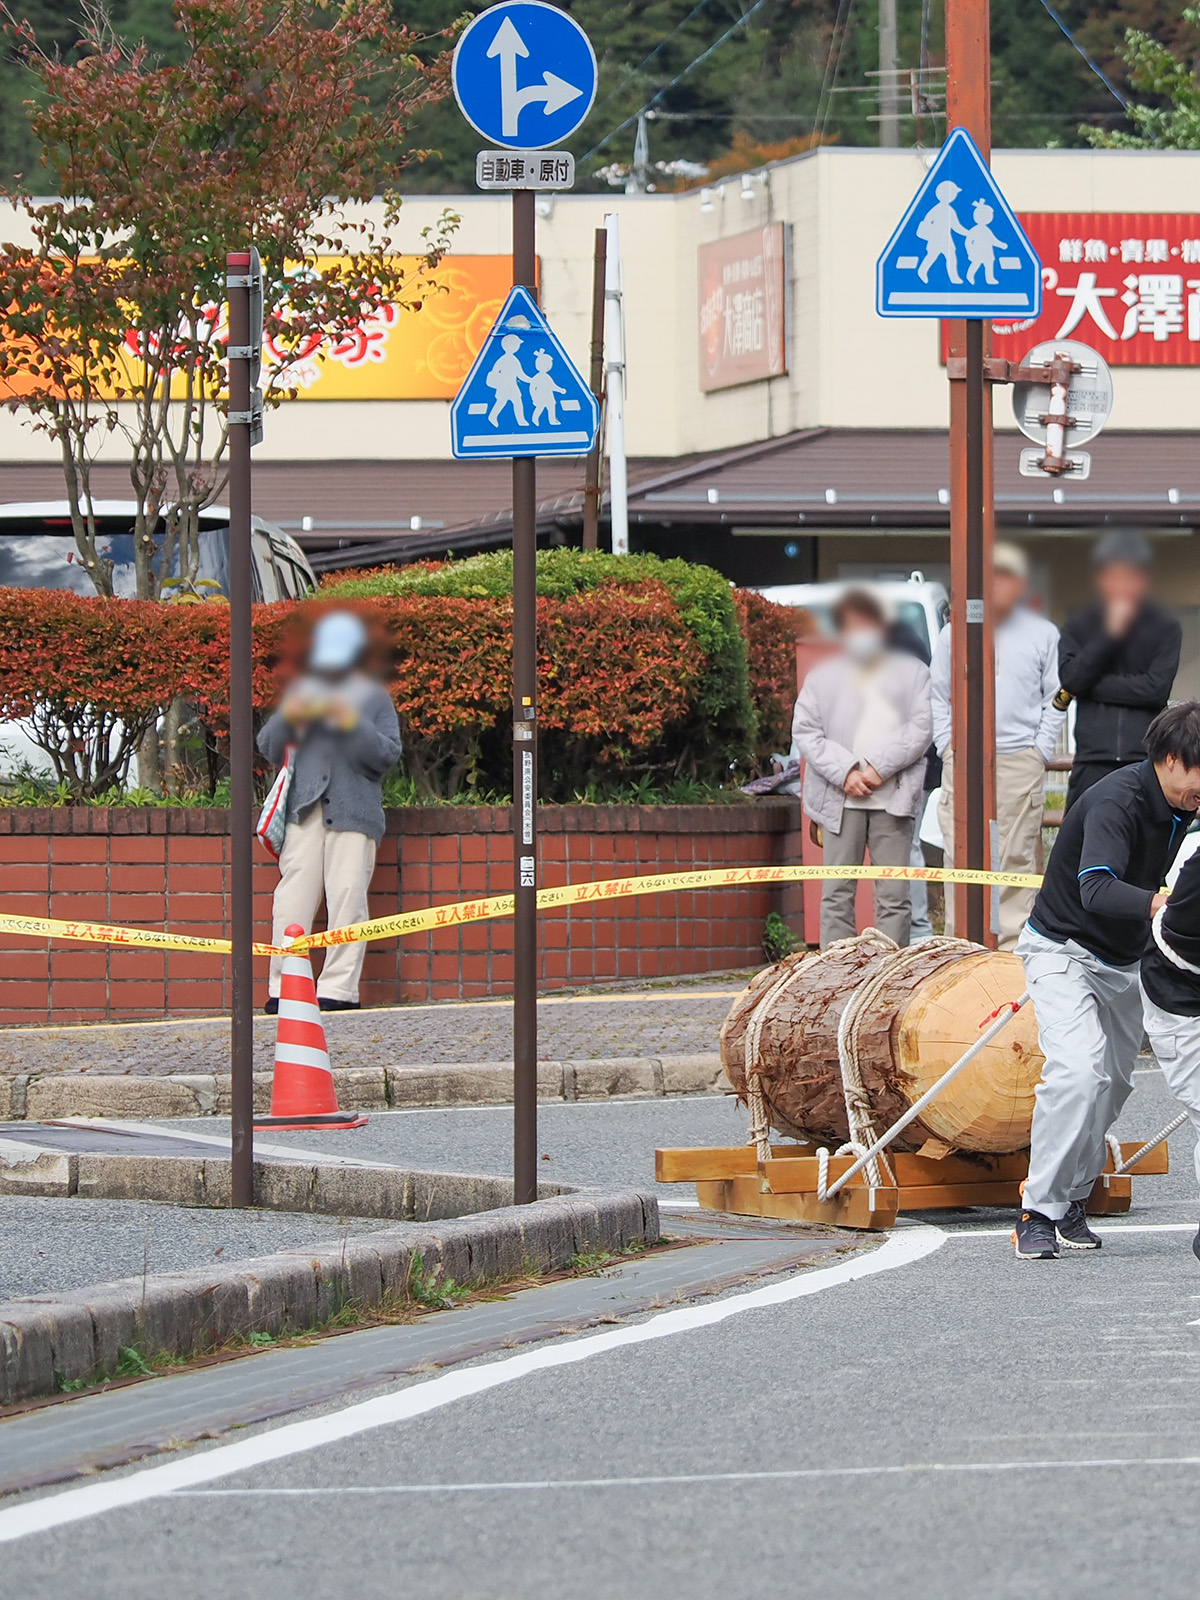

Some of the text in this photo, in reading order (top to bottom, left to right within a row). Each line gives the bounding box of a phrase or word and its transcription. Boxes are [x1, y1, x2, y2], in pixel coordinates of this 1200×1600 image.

[481, 158, 570, 182] 自動車・原付
[359, 916, 425, 937] 入らないでください
[434, 902, 490, 926] 立入禁止
[574, 881, 633, 901] 立入禁止
[637, 875, 712, 889] 入らないでください
[722, 868, 785, 883] 立入禁止
[878, 868, 943, 880] 立入禁止
[947, 871, 1029, 882] 入らないでください
[62, 923, 130, 943] 立入禁止
[134, 932, 217, 948] 入らないでください
